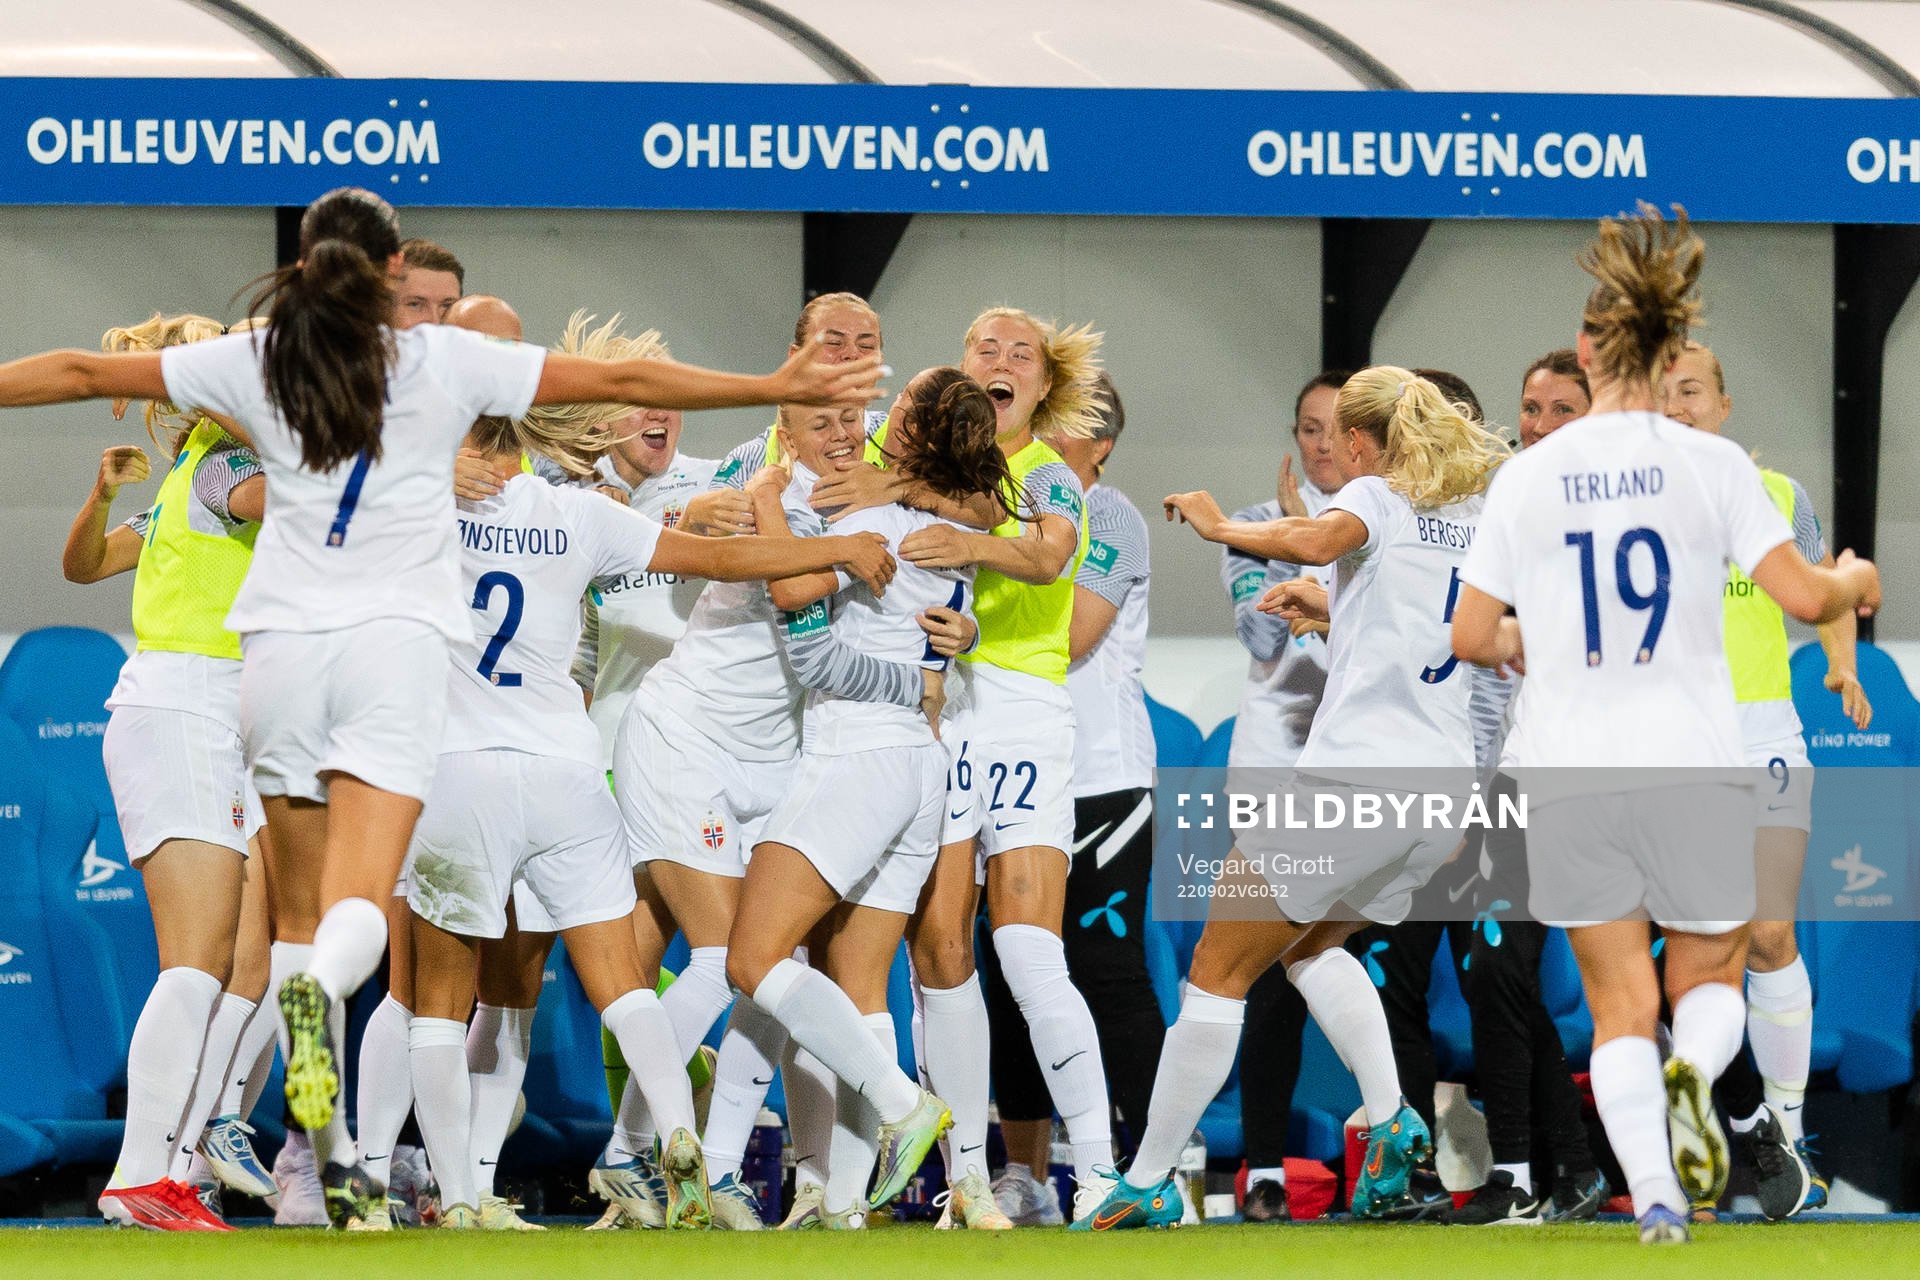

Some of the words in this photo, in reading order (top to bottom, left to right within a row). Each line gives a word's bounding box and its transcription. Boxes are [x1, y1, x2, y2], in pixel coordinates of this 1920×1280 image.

[27, 117, 440, 165] OHLEUVEN.COM
[643, 122, 1049, 173] OHLEUVEN.COM
[1247, 130, 1647, 179] OHLEUVEN.COM
[1846, 137, 1920, 183] OH
[1560, 466, 1664, 504] TERLAND
[795, 604, 825, 627] DNB
[1564, 527, 1671, 668] 19
[472, 571, 525, 687] 2
[1847, 733, 1891, 748] POWER
[988, 760, 1038, 812] 22
[1768, 756, 1790, 794] 9
